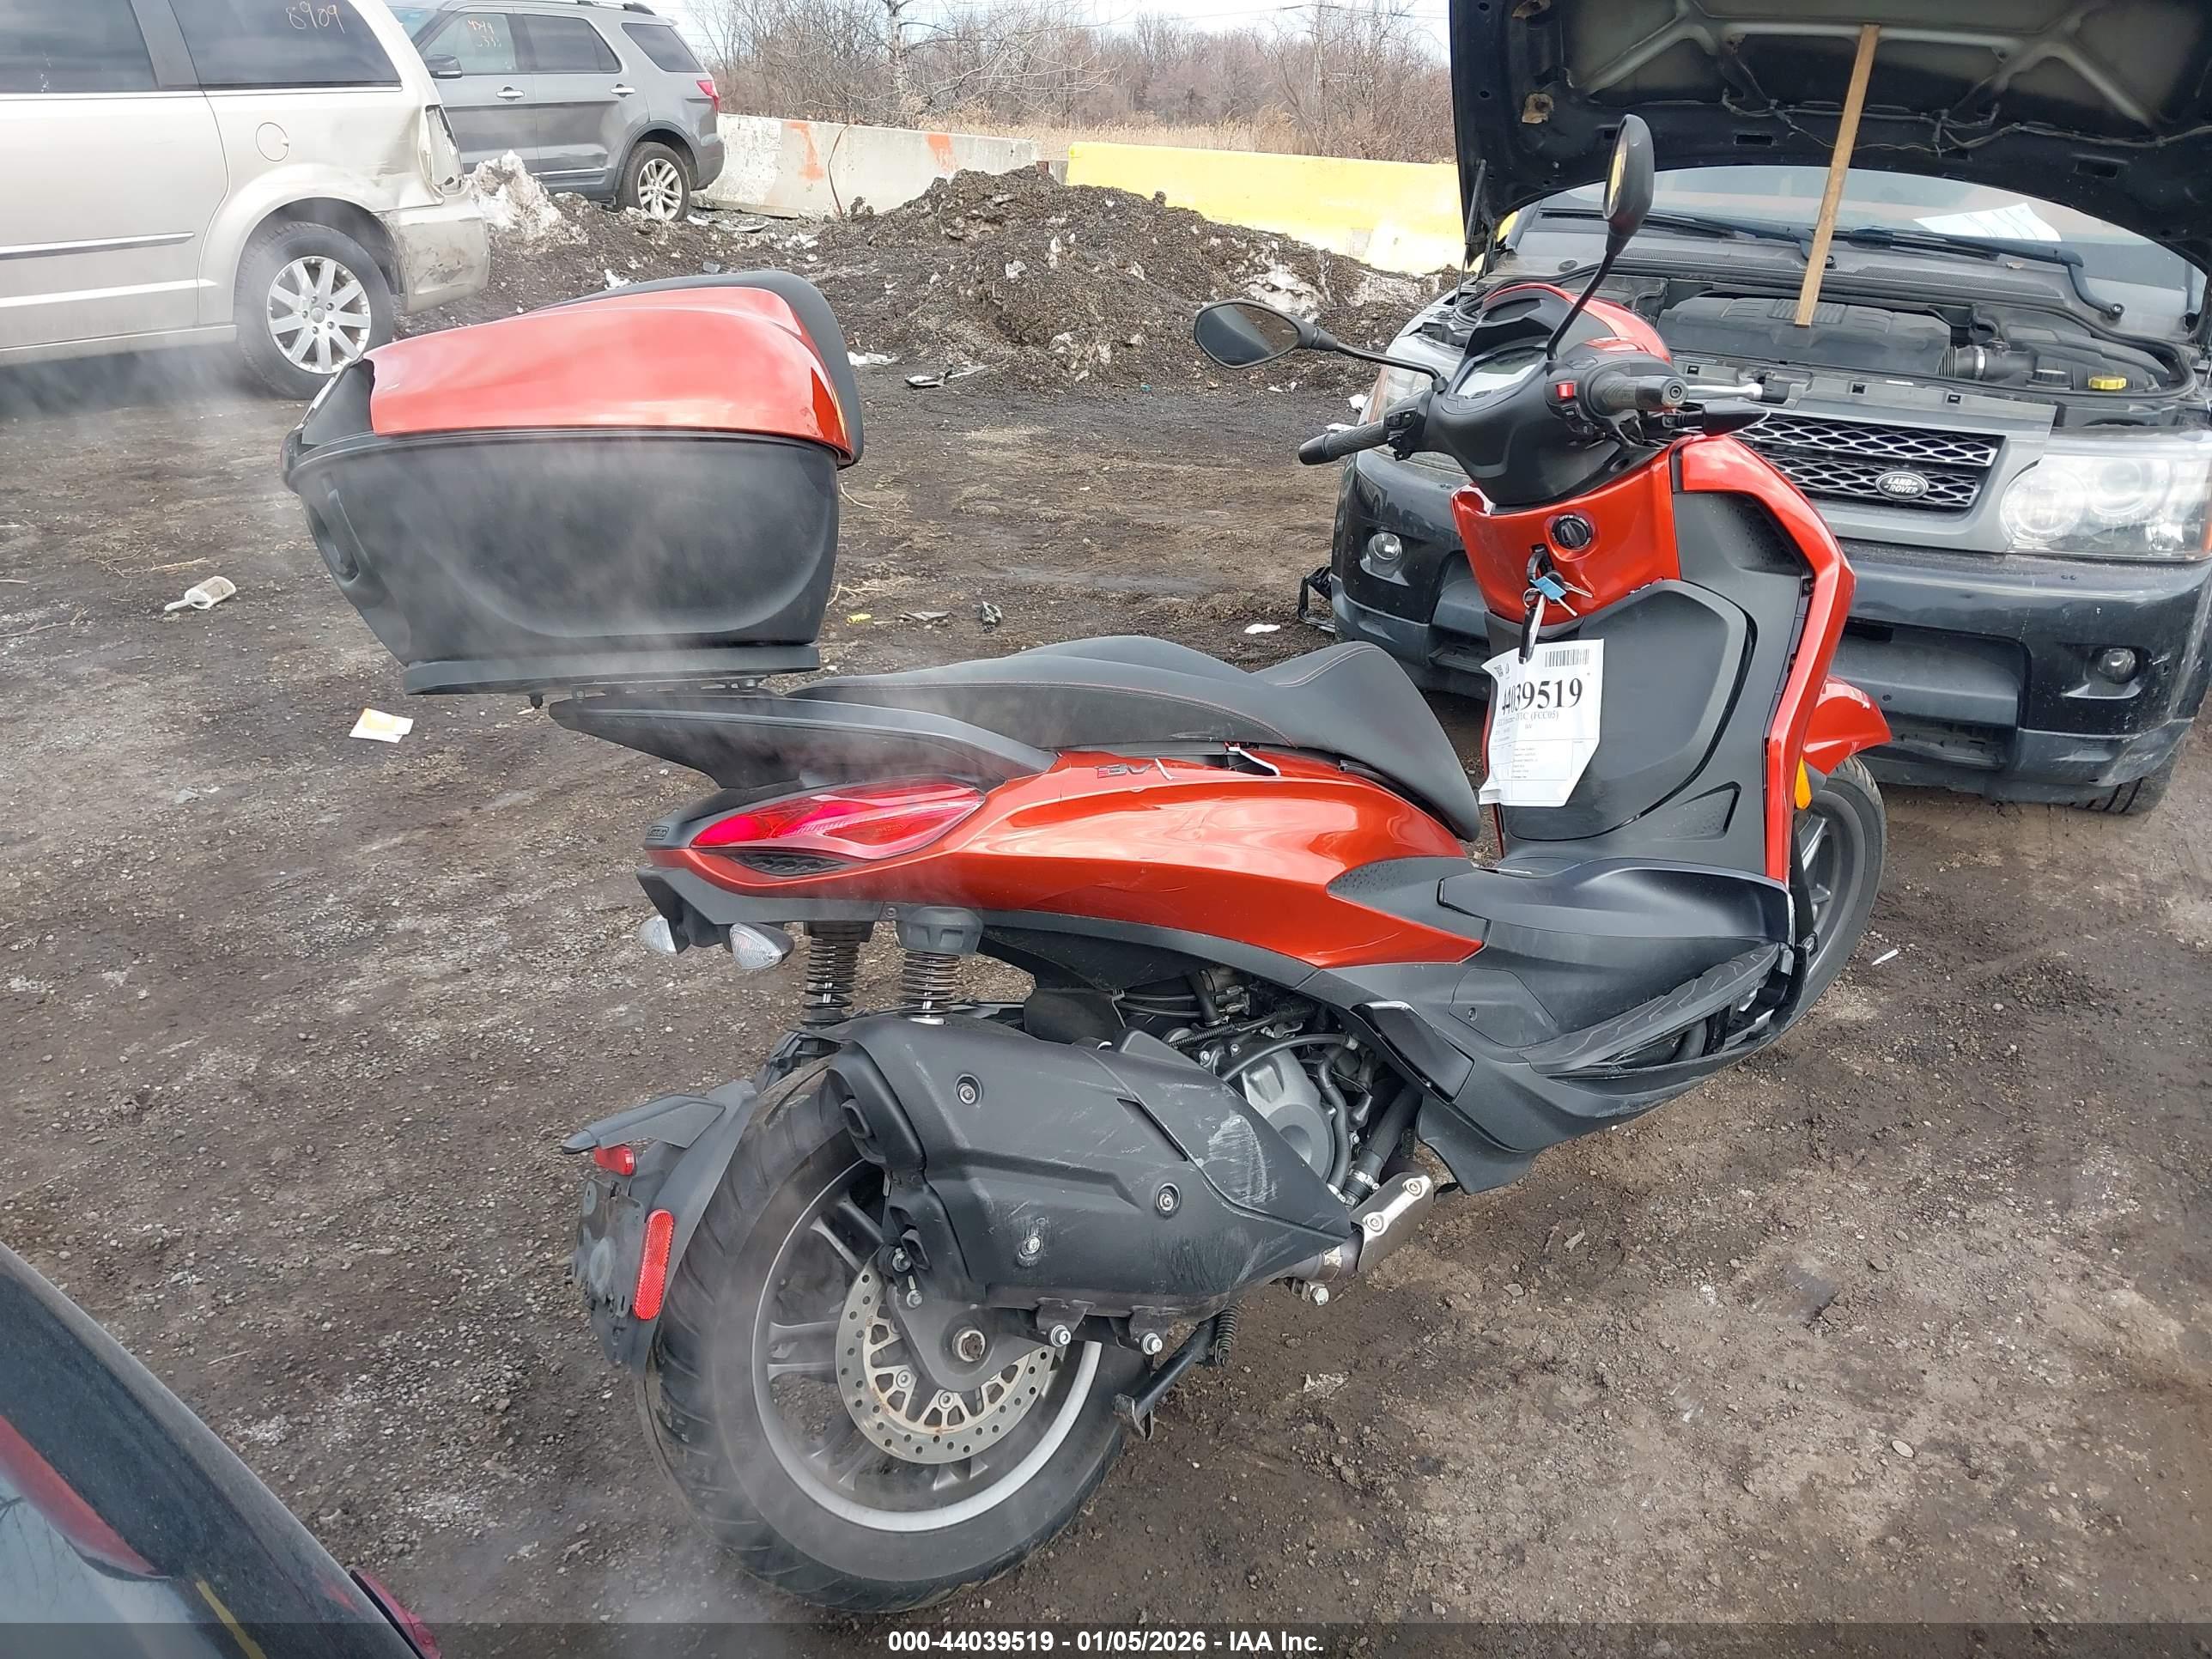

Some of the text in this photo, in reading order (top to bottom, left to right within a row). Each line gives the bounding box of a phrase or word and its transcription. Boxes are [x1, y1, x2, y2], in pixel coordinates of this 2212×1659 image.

[285, 1, 345, 33] 8909
[1887, 477, 1913, 486] LAND
[1888, 485, 1918, 494] ROVER
[1502, 678, 1583, 715] 44039519
